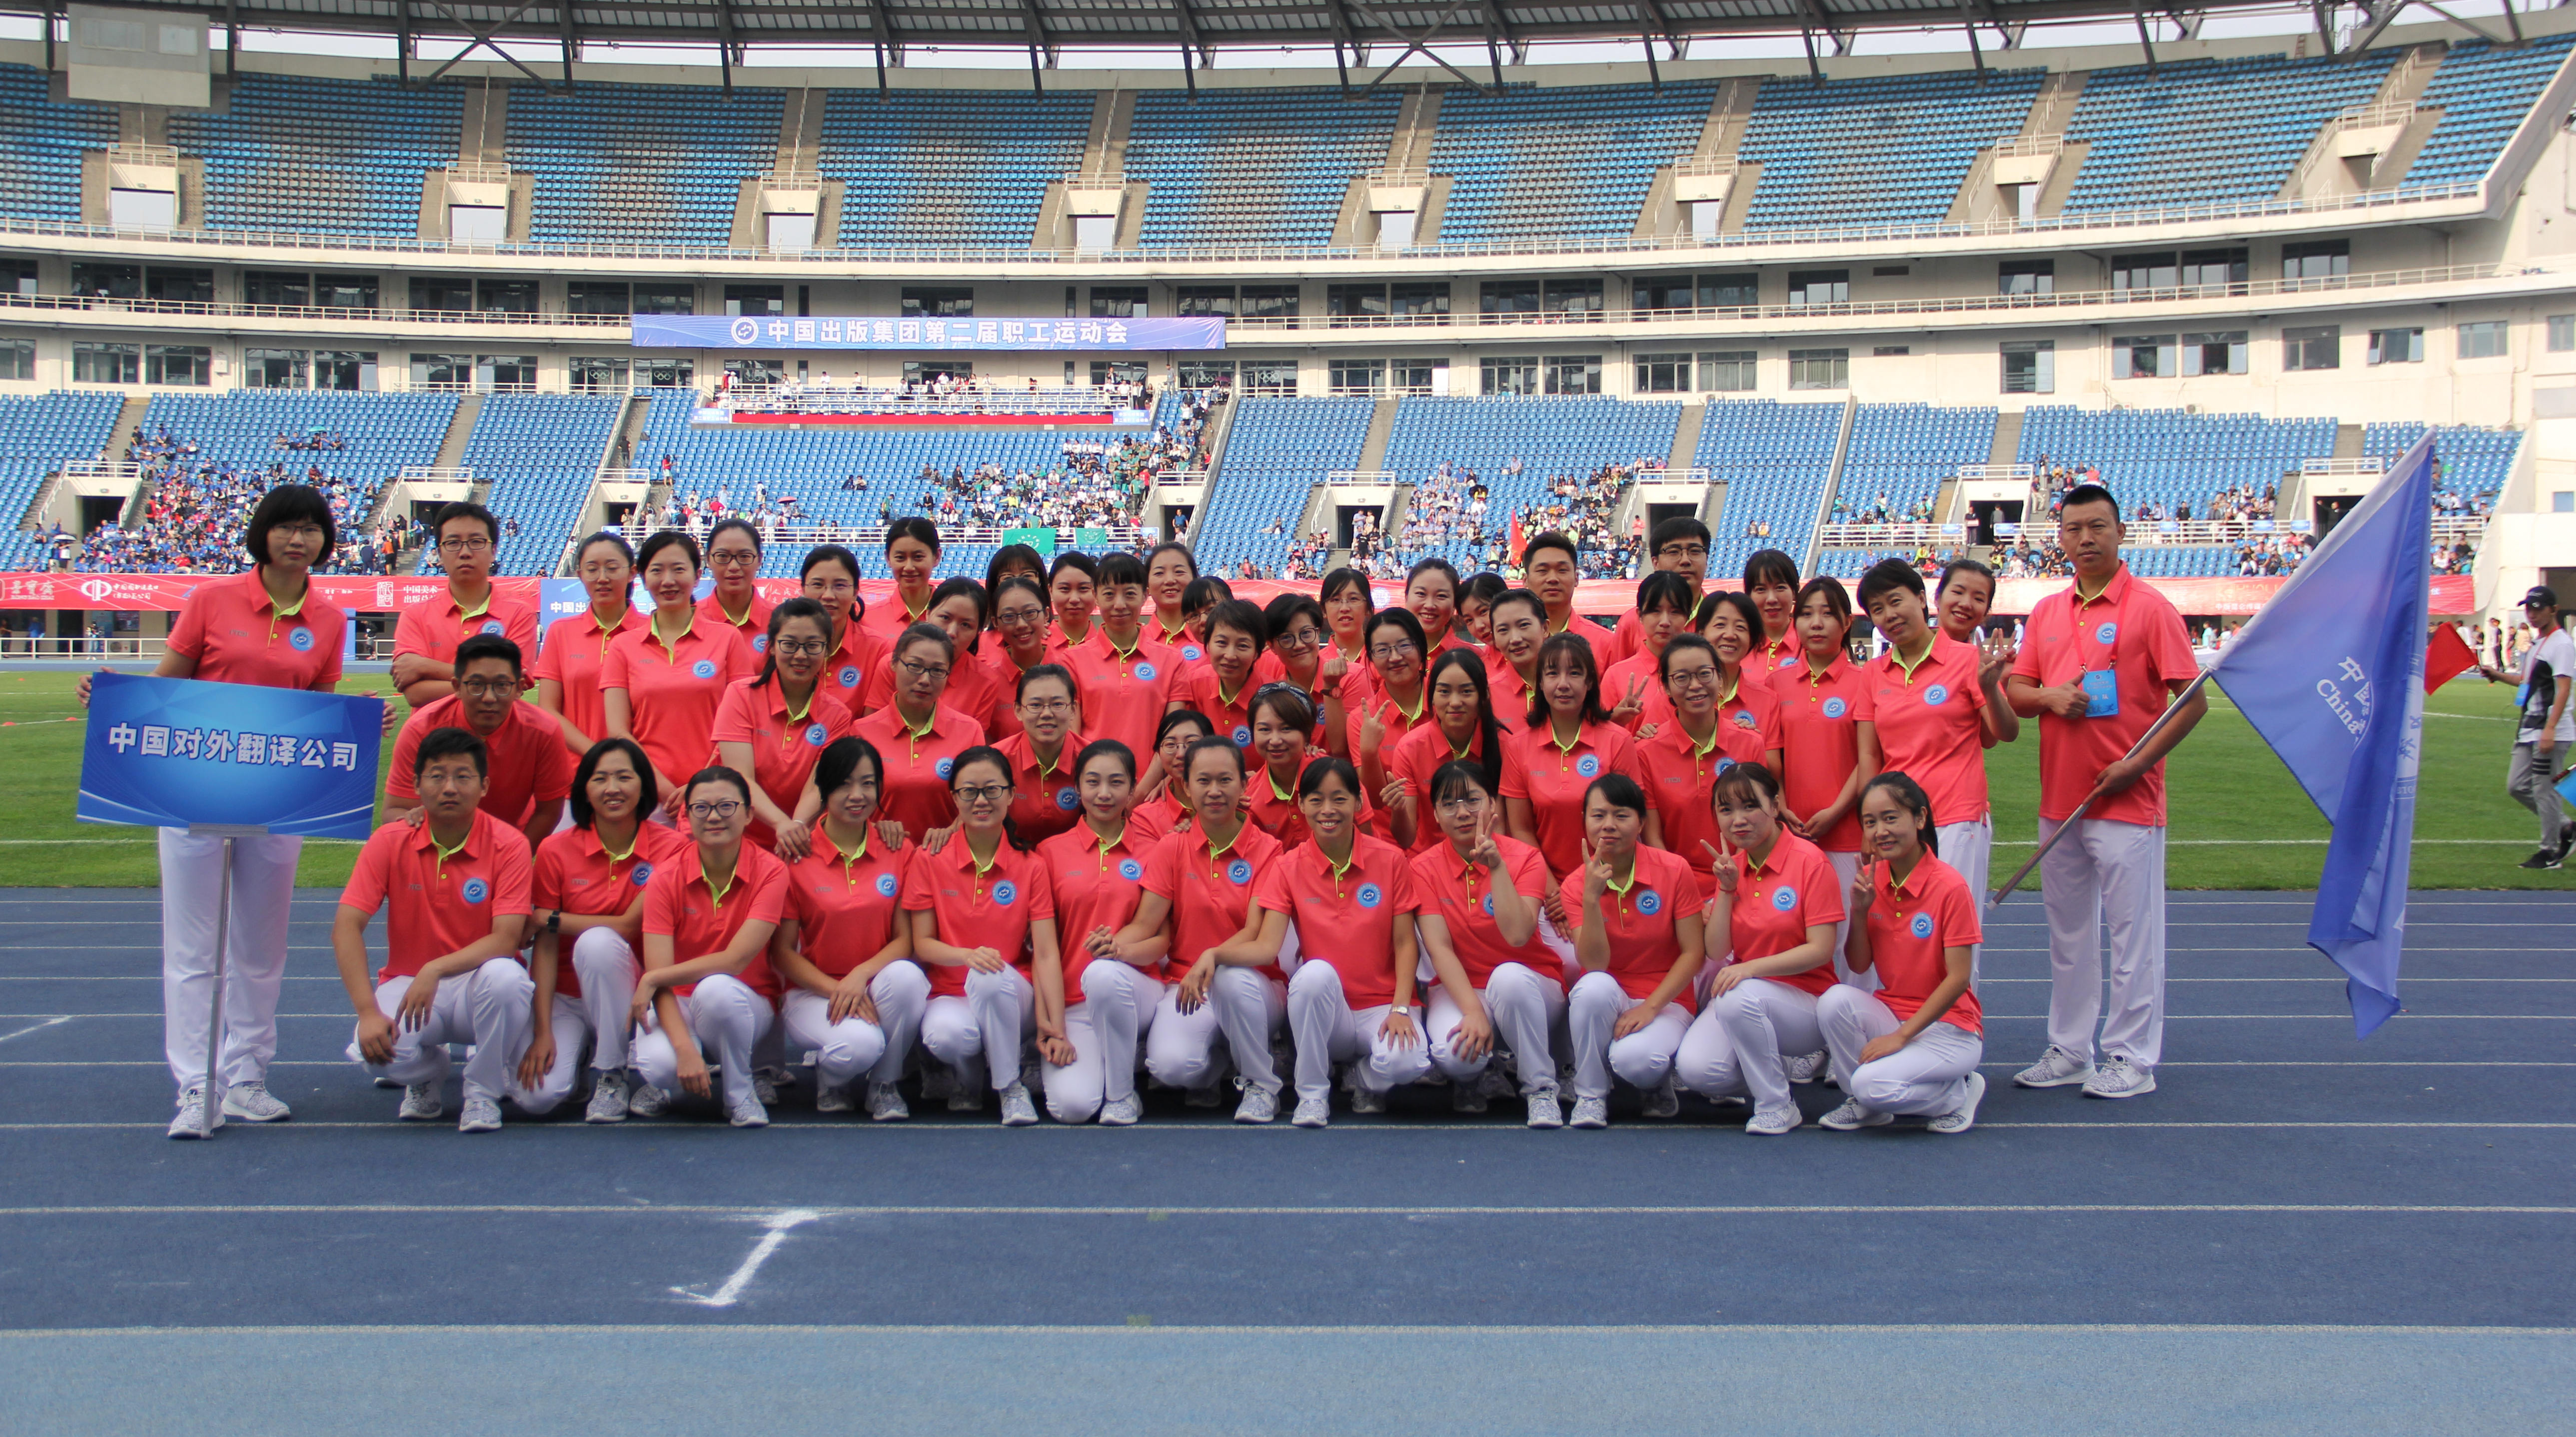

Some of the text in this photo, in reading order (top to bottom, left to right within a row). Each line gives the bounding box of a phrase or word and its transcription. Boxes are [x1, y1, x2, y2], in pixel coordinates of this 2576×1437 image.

[768, 318, 1128, 344] 中国出版集团第二届职工运动会
[403, 585, 438, 594] 中国美术
[550, 601, 587, 613] 中国出
[2316, 679, 2361, 735] China
[109, 722, 358, 771] 中国对外翻译公司
